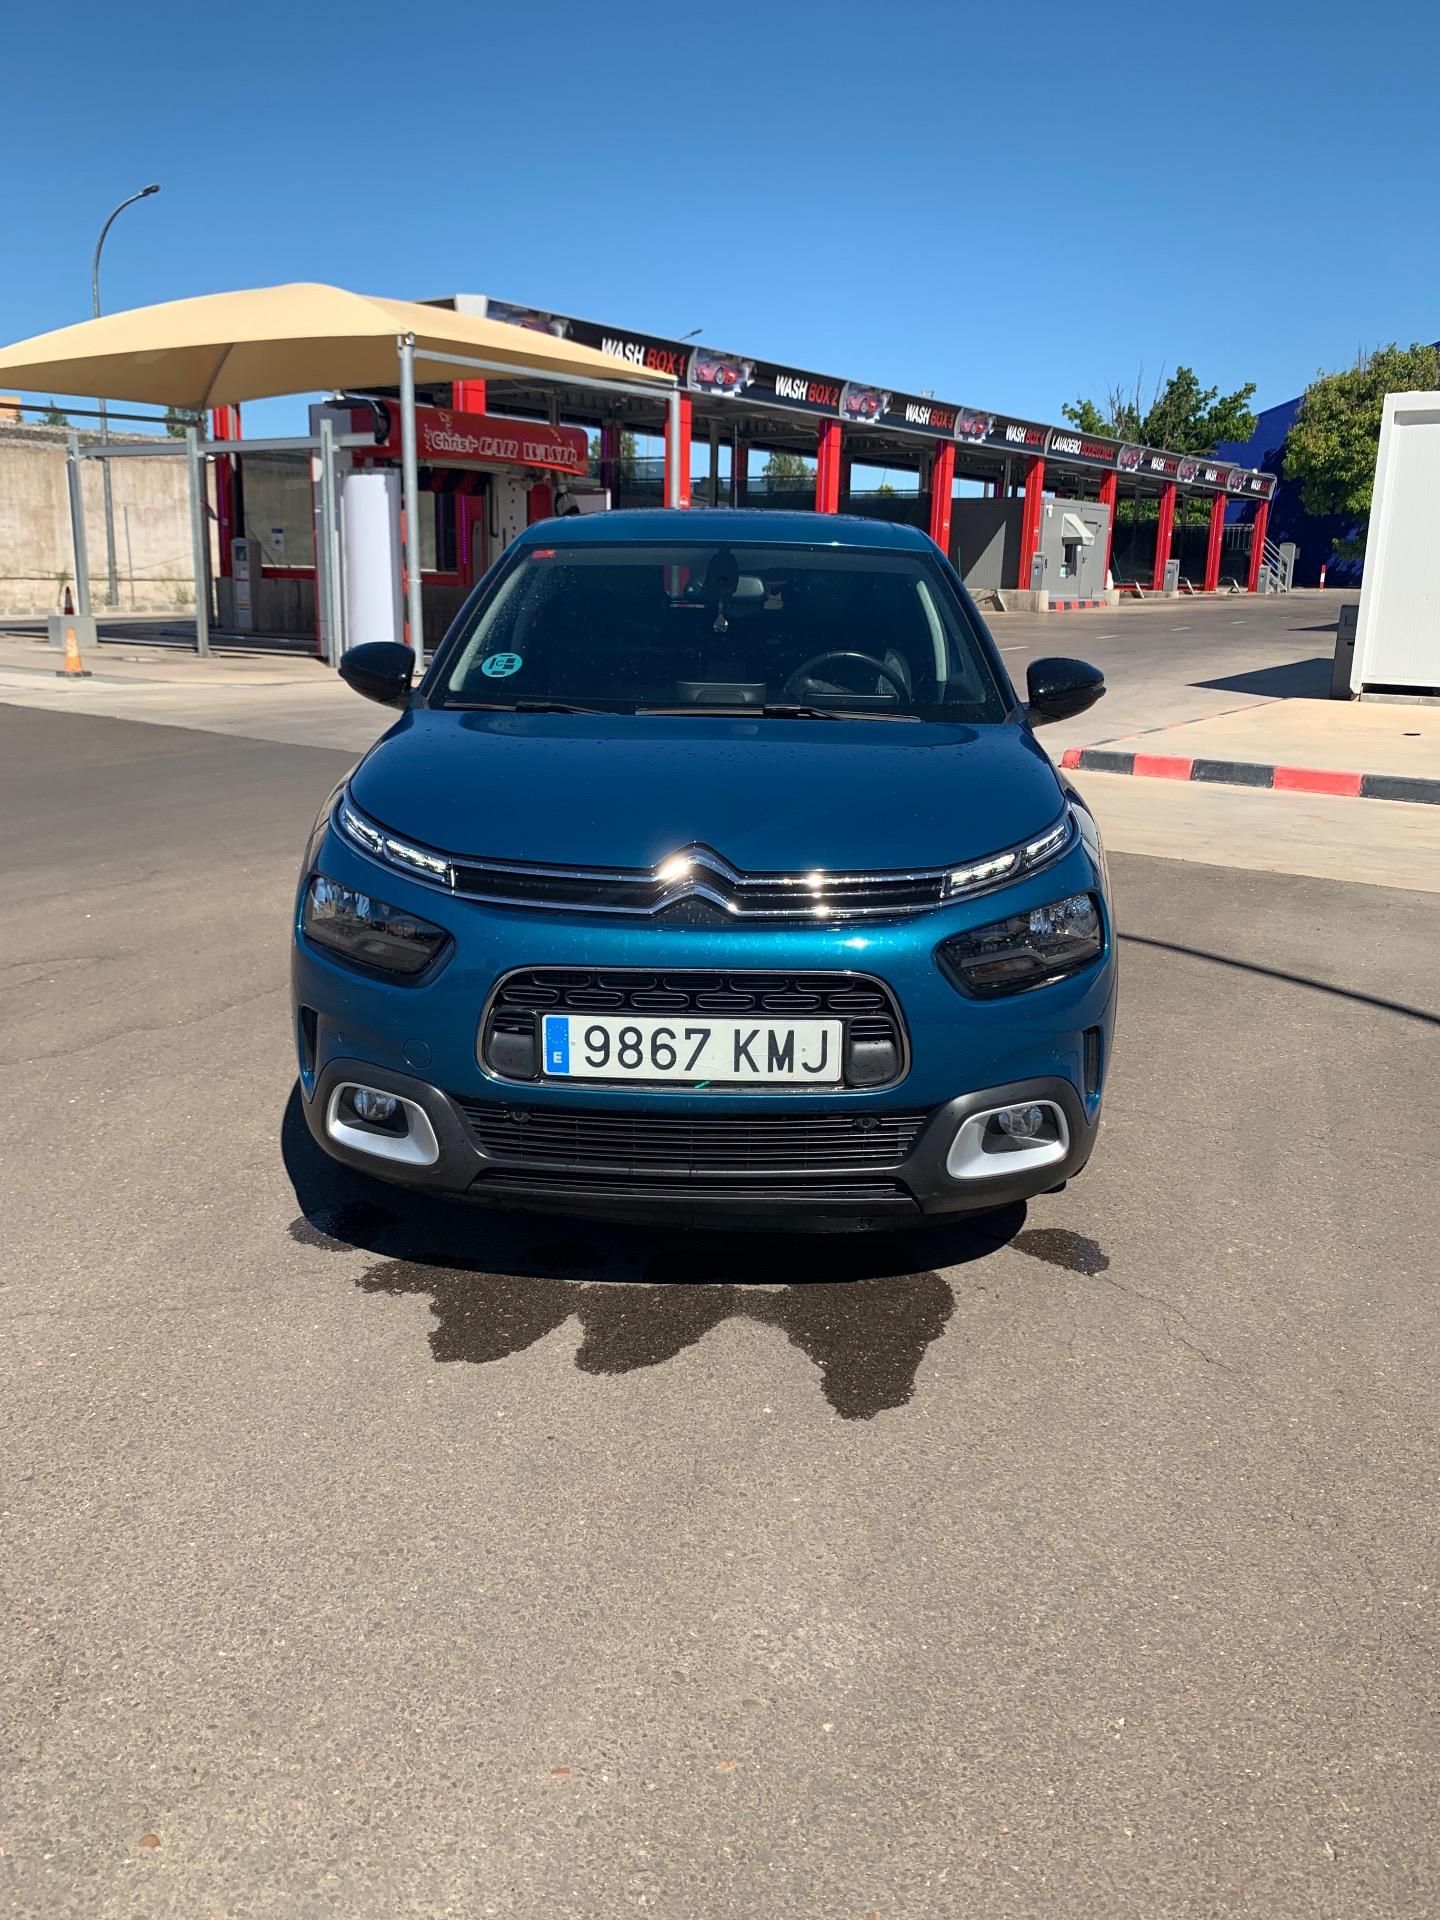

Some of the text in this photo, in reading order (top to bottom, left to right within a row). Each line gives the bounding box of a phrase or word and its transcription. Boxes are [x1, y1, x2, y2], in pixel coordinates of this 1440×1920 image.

[602, 337, 687, 377] WASH BOX 1
[775, 375, 839, 407] WASH BOX 2
[905, 403, 932, 425] WASH
[930, 409, 949, 429] BOX
[431, 431, 479, 454] Christ
[478, 436, 519, 459] CAR
[1005, 425, 1027, 443] WASH
[1051, 434, 1082, 455] LAVADERO
[553, 1051, 563, 1064] E
[584, 1024, 829, 1074] 9867 KMJ
